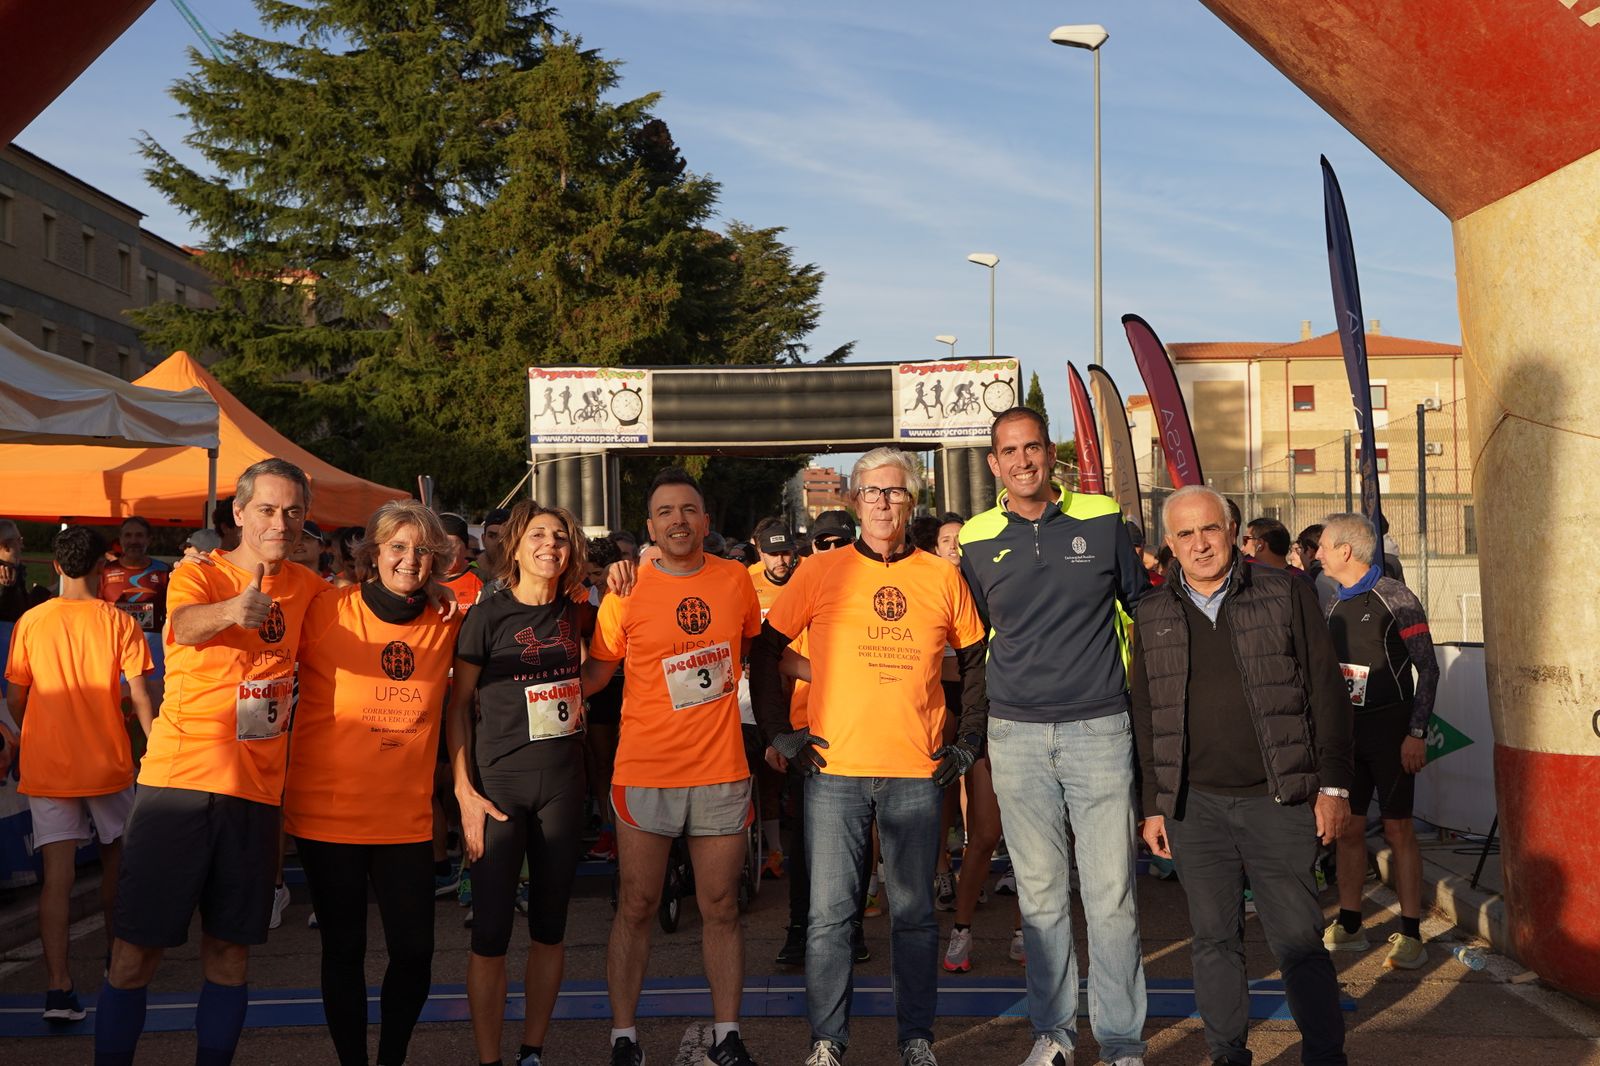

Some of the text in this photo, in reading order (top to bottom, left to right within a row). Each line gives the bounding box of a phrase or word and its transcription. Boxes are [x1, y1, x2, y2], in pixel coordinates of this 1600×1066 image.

[537, 435, 640, 444] www.orycronsport.com
[867, 626, 914, 642] UPSA
[884, 653, 920, 661] EDUCACIÓN
[513, 670, 549, 682] UNDER
[697, 668, 712, 689] 3
[375, 685, 423, 703] UPSA
[267, 701, 278, 723] 5
[361, 714, 376, 722] POR
[378, 715, 387, 723] LA
[362, 707, 402, 716] CORREMOS
[557, 701, 569, 722] 8
